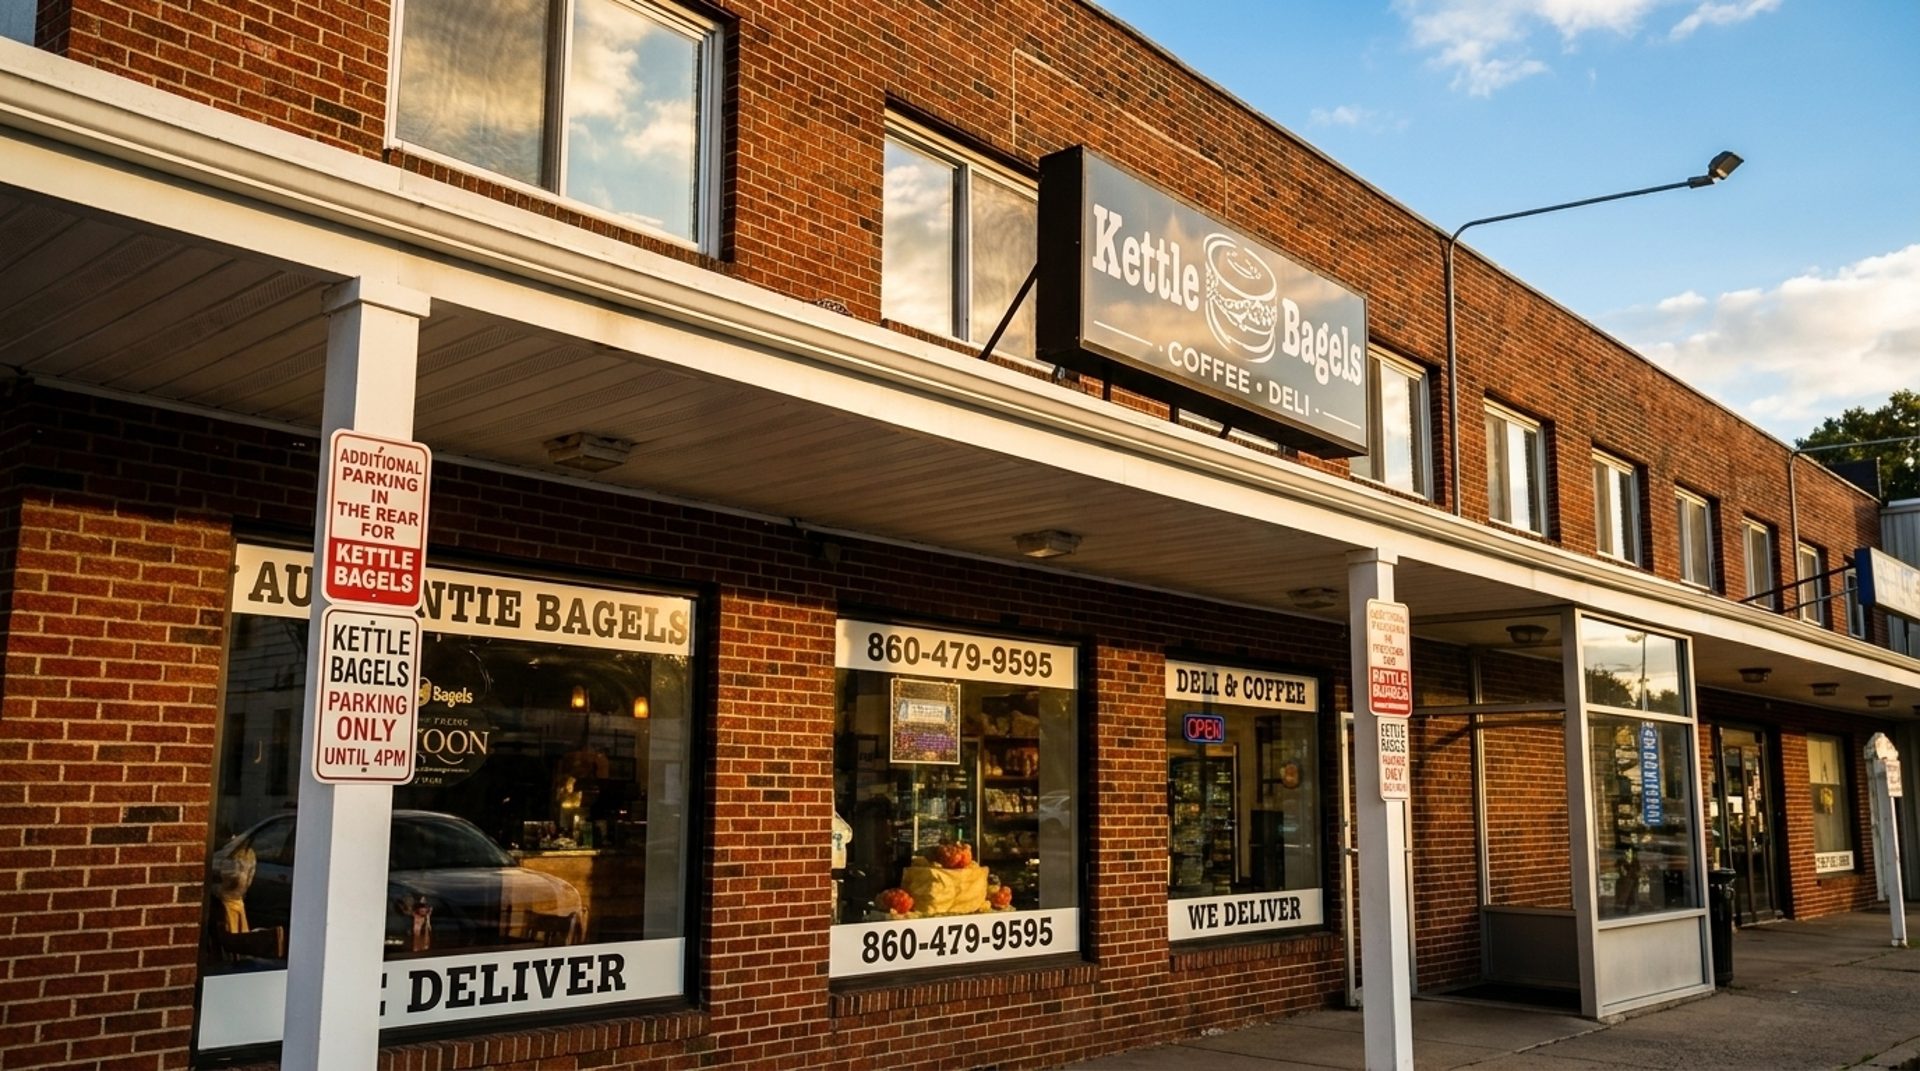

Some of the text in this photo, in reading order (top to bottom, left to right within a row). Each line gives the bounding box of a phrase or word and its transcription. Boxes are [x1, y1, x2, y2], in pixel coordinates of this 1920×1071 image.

[1092, 203, 1362, 386] Kettle Bagels
[1167, 341, 1310, 416] COFFEE DELI
[340, 448, 422, 475] ADDITIONAL
[342, 467, 418, 492] PARKING
[371, 490, 389, 505] IN
[337, 502, 419, 527] THE REAR
[361, 523, 395, 540] FOR
[336, 543, 413, 571] KETTLE
[334, 566, 413, 593] BAGELS
[536, 593, 689, 645] BAGELS
[332, 624, 410, 656] KETTLE
[867, 632, 1053, 679] 860-479-9595
[330, 656, 409, 688] BAGELS
[433, 685, 473, 708] Bagels
[1176, 669, 1306, 704] DELI & COFFEE
[328, 691, 407, 715] PARKING
[336, 716, 397, 743] ONLY
[1187, 718, 1222, 740] OPEN
[324, 747, 406, 767] UNTIL 4PM
[1187, 896, 1302, 930] WE DELIVER
[862, 917, 1053, 964] 860-479-9595
[406, 953, 627, 1014] DELIVER
